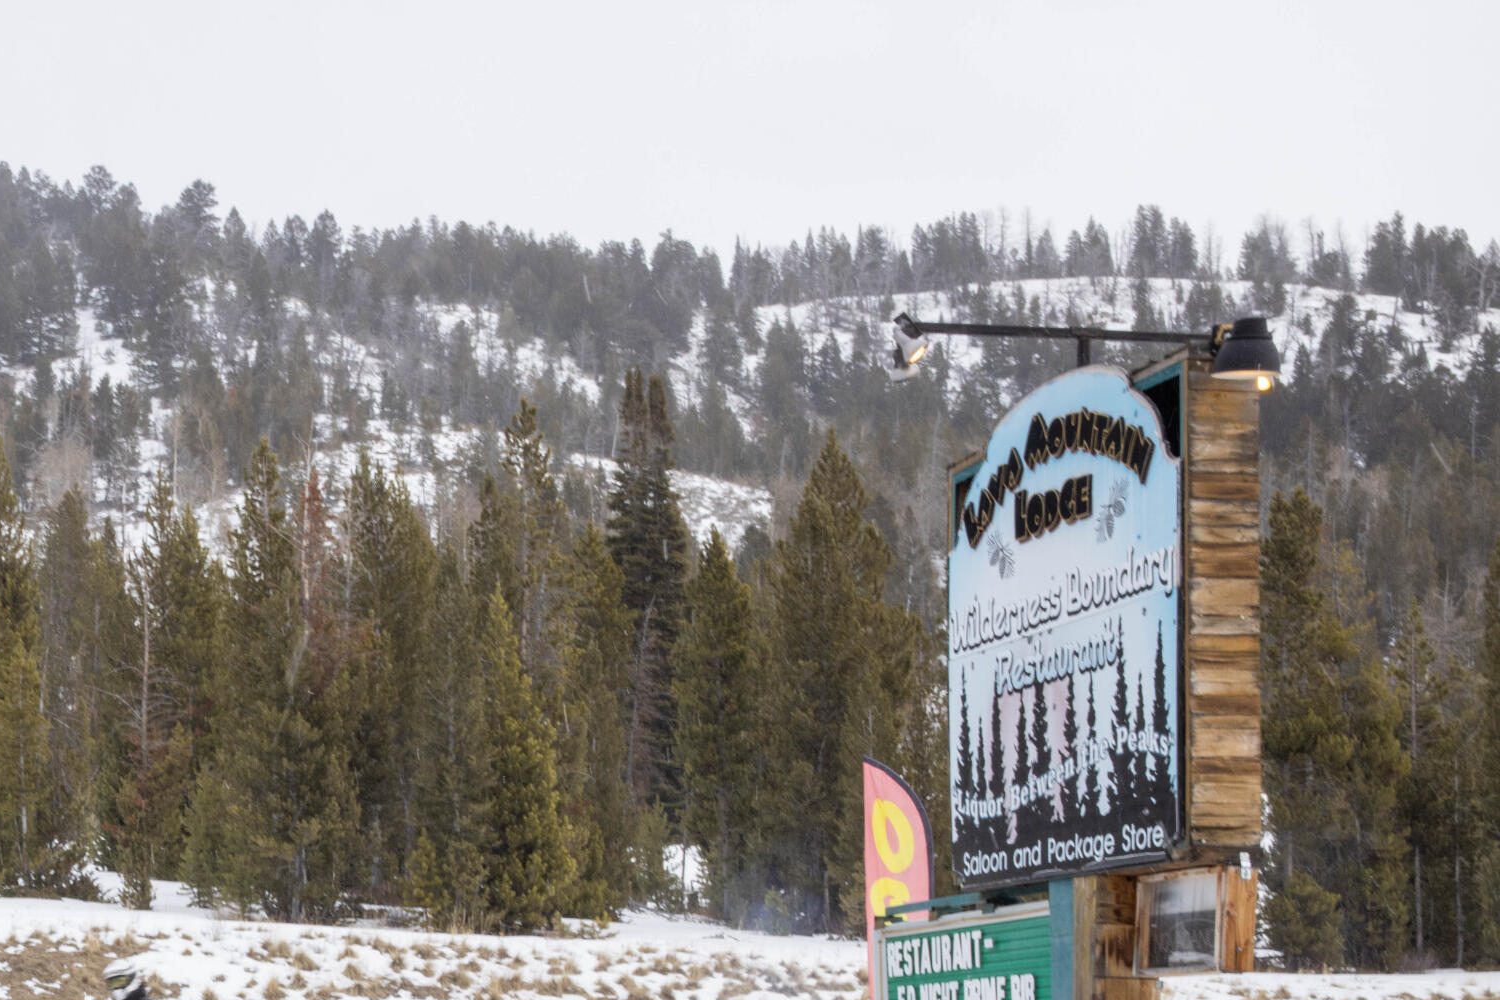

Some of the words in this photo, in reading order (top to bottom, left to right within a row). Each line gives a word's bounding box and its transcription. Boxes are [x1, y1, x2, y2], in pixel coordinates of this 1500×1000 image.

[963, 447, 1024, 550] LAVA
[1024, 406, 1155, 486] MOUNTAIN
[1014, 474, 1093, 543] LODGE
[950, 585, 1063, 654] Wilderness
[1066, 545, 1176, 616] Boundary
[996, 616, 1118, 697] Restaurant
[1010, 757, 1075, 812] Between
[1076, 736, 1109, 773] the
[962, 850, 1008, 878] Saloon
[1012, 839, 1042, 869] and
[1047, 833, 1116, 863] Package
[1121, 823, 1165, 852] Store
